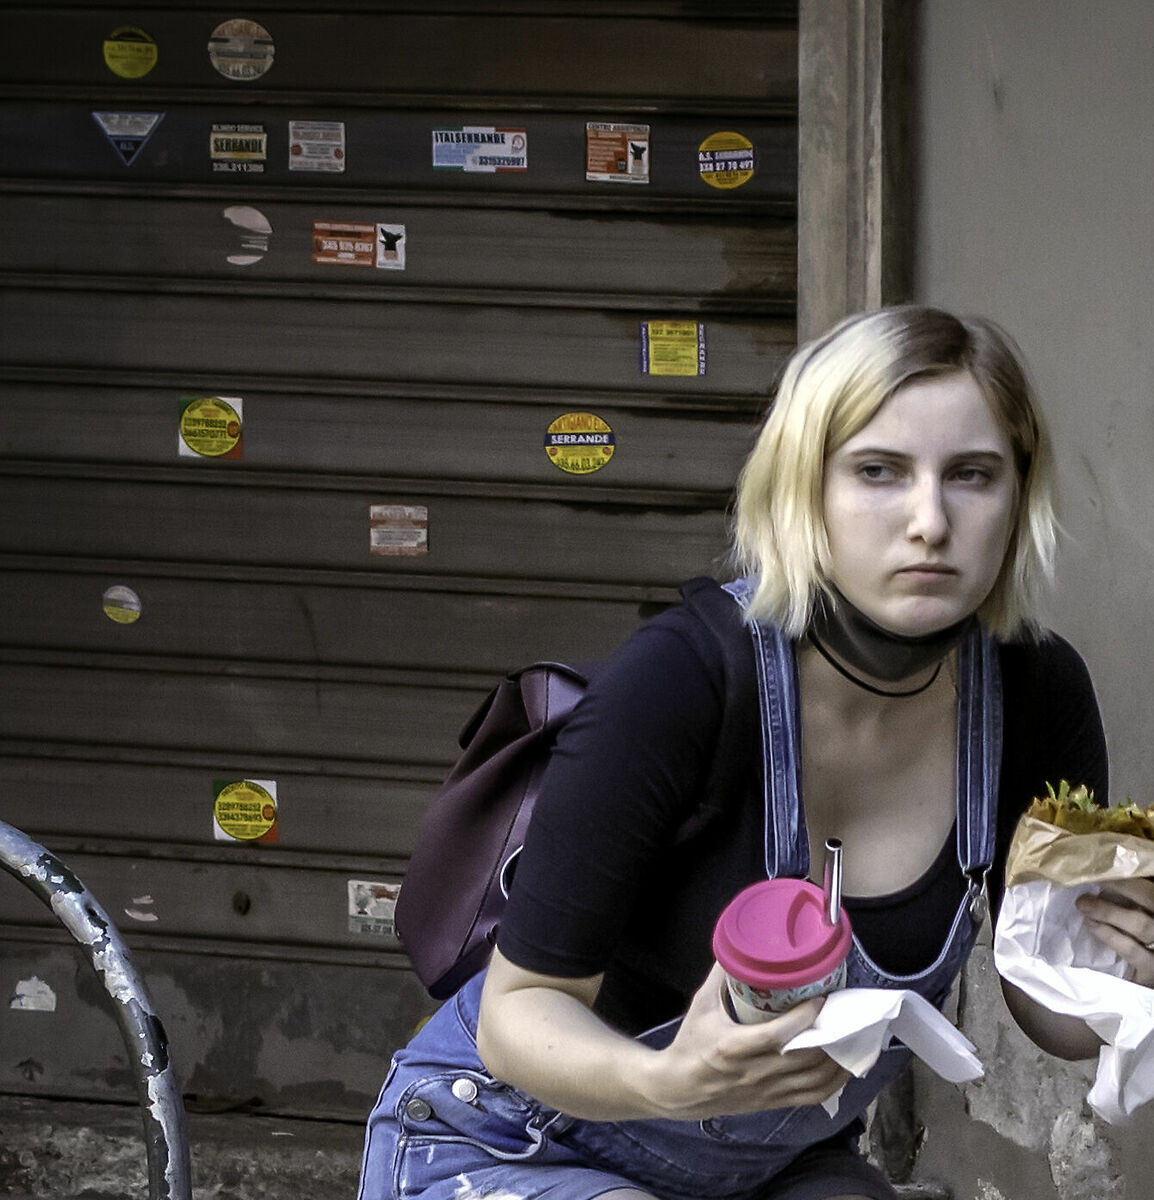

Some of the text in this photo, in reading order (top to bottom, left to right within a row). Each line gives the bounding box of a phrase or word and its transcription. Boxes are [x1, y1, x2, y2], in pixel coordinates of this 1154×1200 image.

[435, 132, 505, 144] ITALSERRANDE
[214, 138, 262, 152] SERRANDE
[551, 434, 609, 444] SERRANDE
